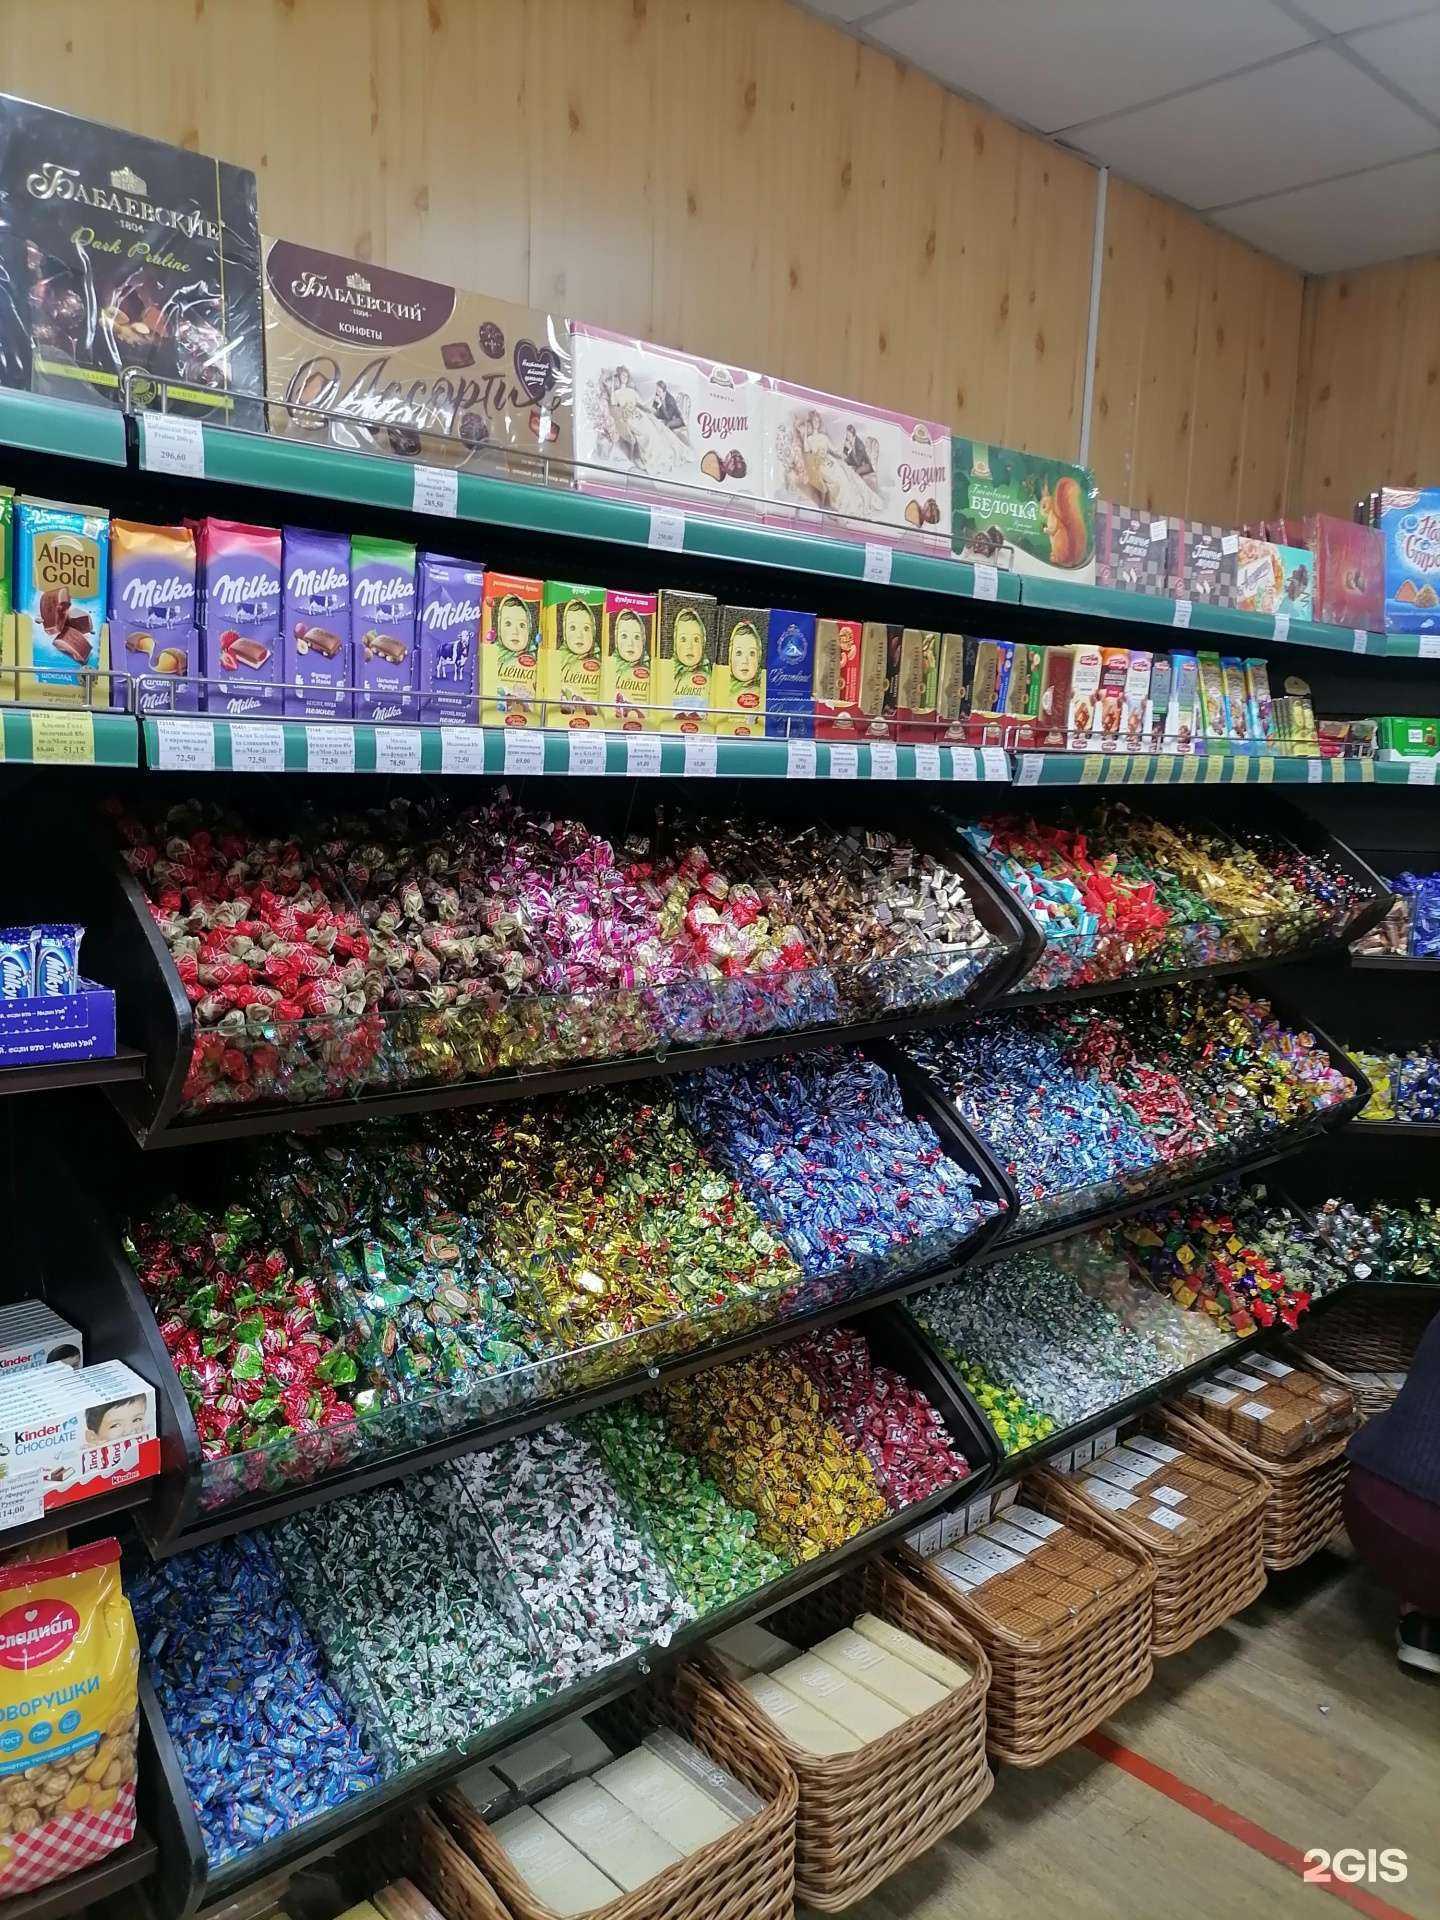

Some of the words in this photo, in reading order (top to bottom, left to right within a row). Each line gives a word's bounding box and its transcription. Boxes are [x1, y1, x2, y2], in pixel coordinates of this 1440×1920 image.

[70, 226, 122, 255] Dark
[127, 242, 192, 273] Praline
[290, 271, 424, 321] БАБАЕВСКИЙ
[338, 321, 383, 341] КОНФЕТЫ
[697, 411, 749, 440] Визит
[897, 463, 947, 493] Визит
[970, 495, 1038, 521] БЕЛОЧКА
[38, 542, 95, 571] Alpen
[42, 565, 90, 588] Gold
[212, 573, 281, 605] Milka
[286, 566, 349, 597] Milka
[122, 576, 195, 610] Milka
[353, 577, 416, 607] Milka
[422, 600, 481, 631] Milka
[226, 696, 262, 714] Milka
[371, 705, 402, 721] Milka
[175, 754, 196, 763] 72,50
[320, 757, 339, 765] 72,50
[15, 1424, 61, 1445] Kinder
[15, 1429, 77, 1456] CHOCOLATE
